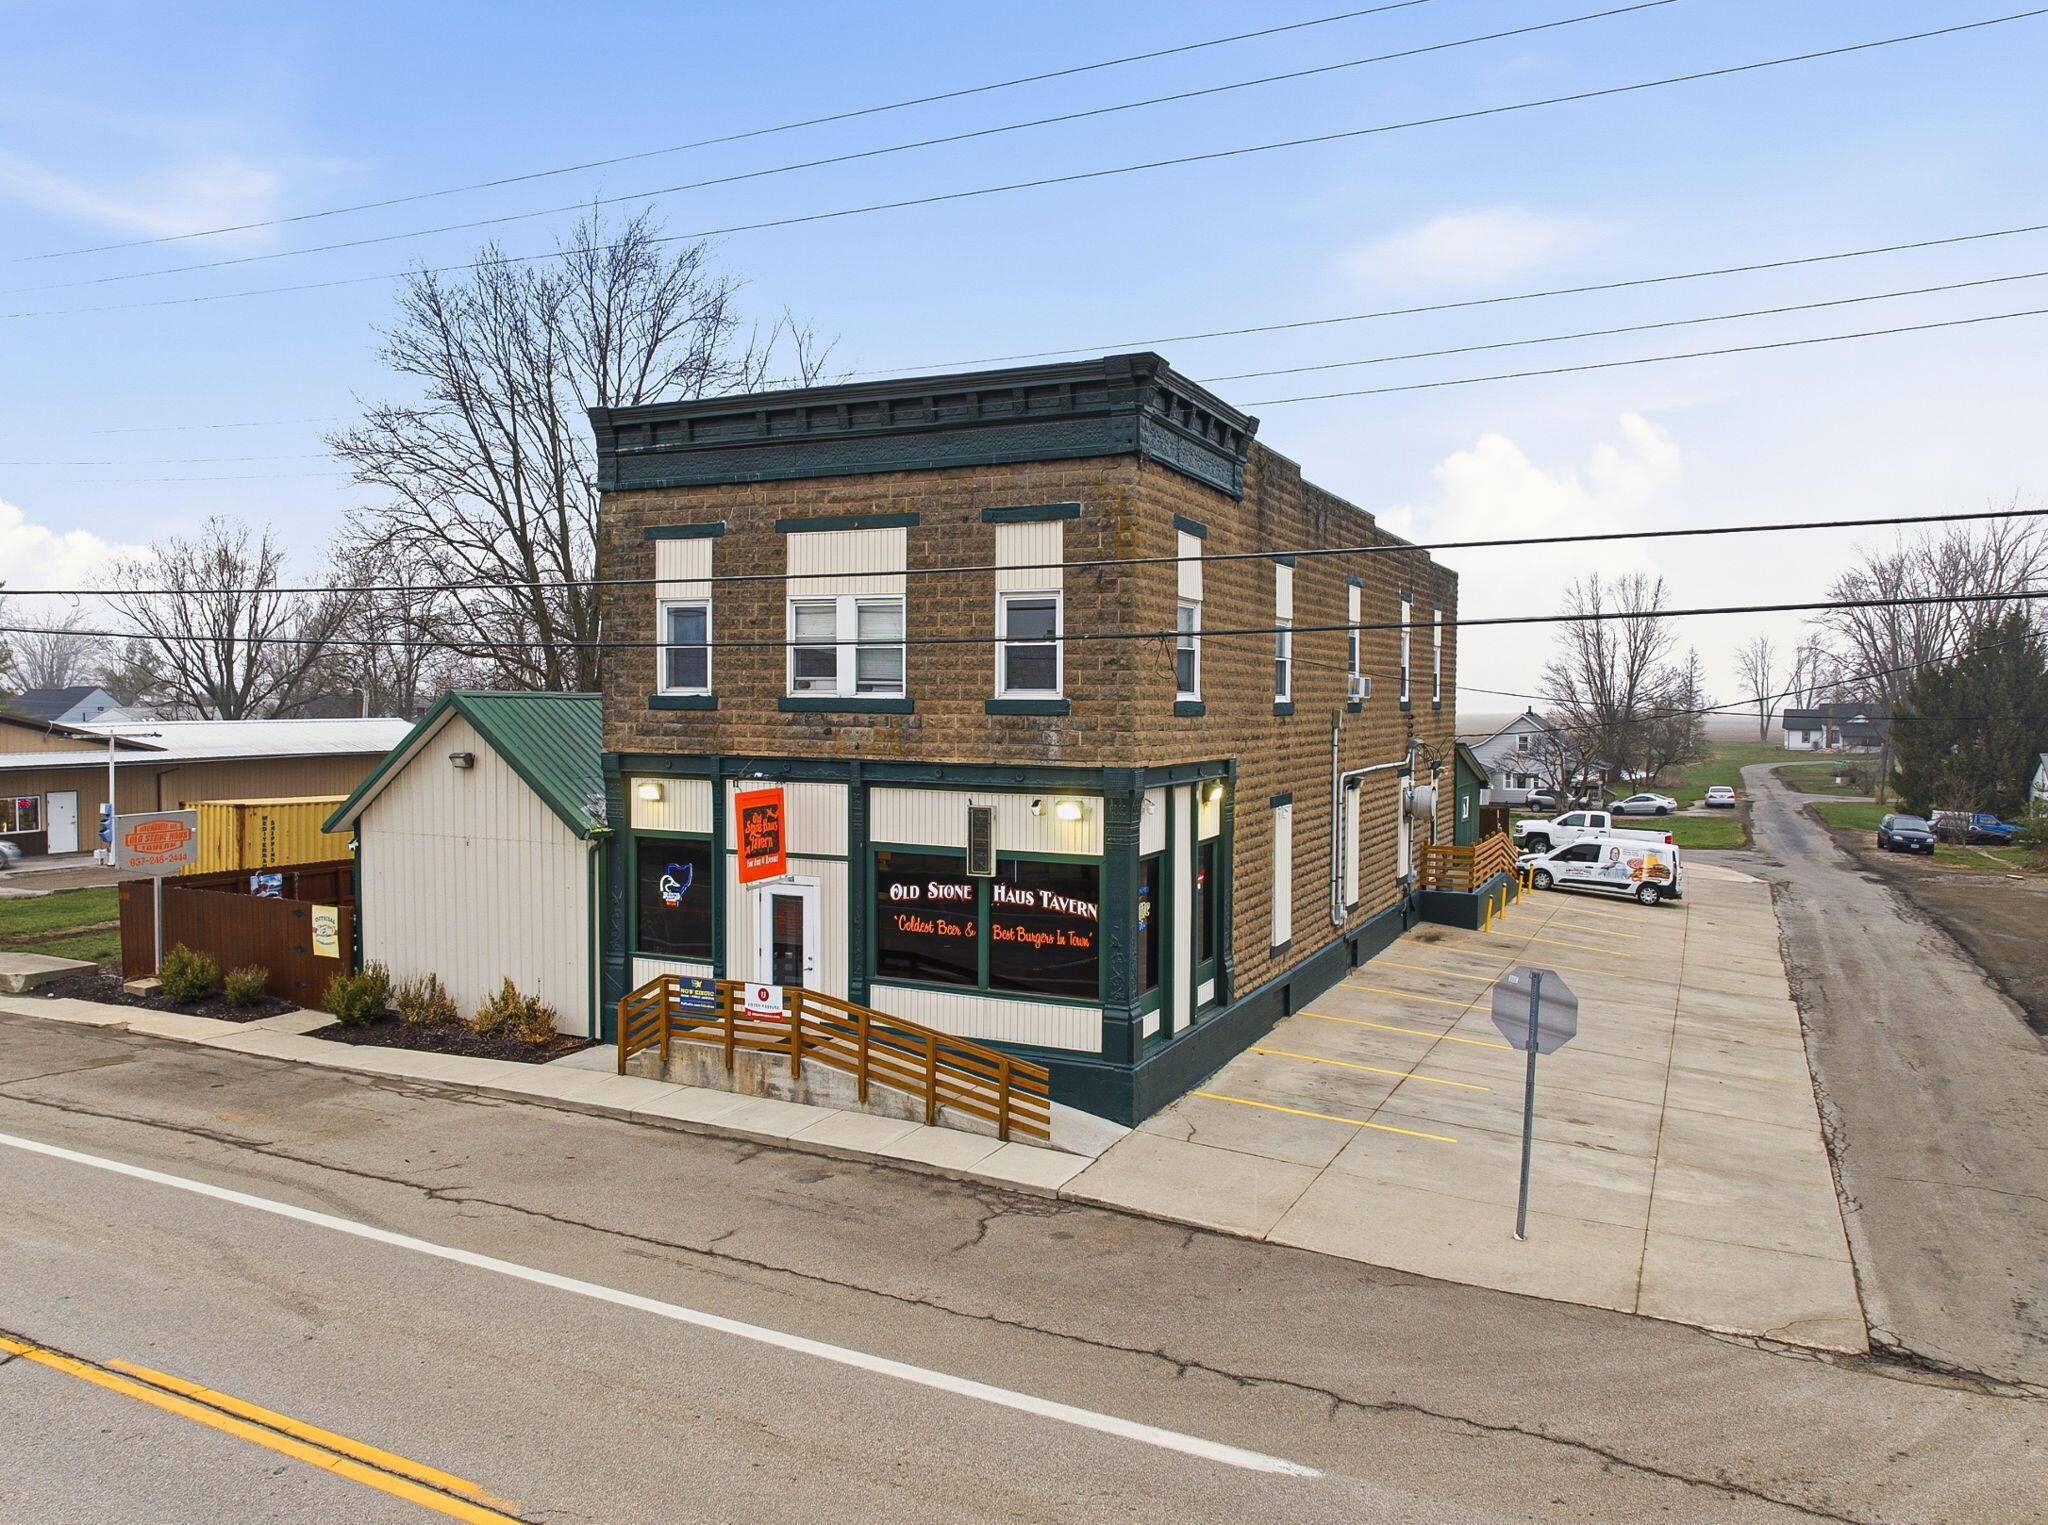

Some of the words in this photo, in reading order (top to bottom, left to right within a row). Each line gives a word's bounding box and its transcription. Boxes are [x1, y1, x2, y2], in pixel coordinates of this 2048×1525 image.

[890, 883, 920, 900] OLD
[928, 881, 972, 901] STONE
[993, 882, 1035, 906] HAUS
[1038, 889, 1098, 922] TAVERN
[965, 921, 977, 937] &
[991, 924, 1016, 941] Best
[1016, 925, 1055, 949] Burgers
[1057, 929, 1066, 945] In
